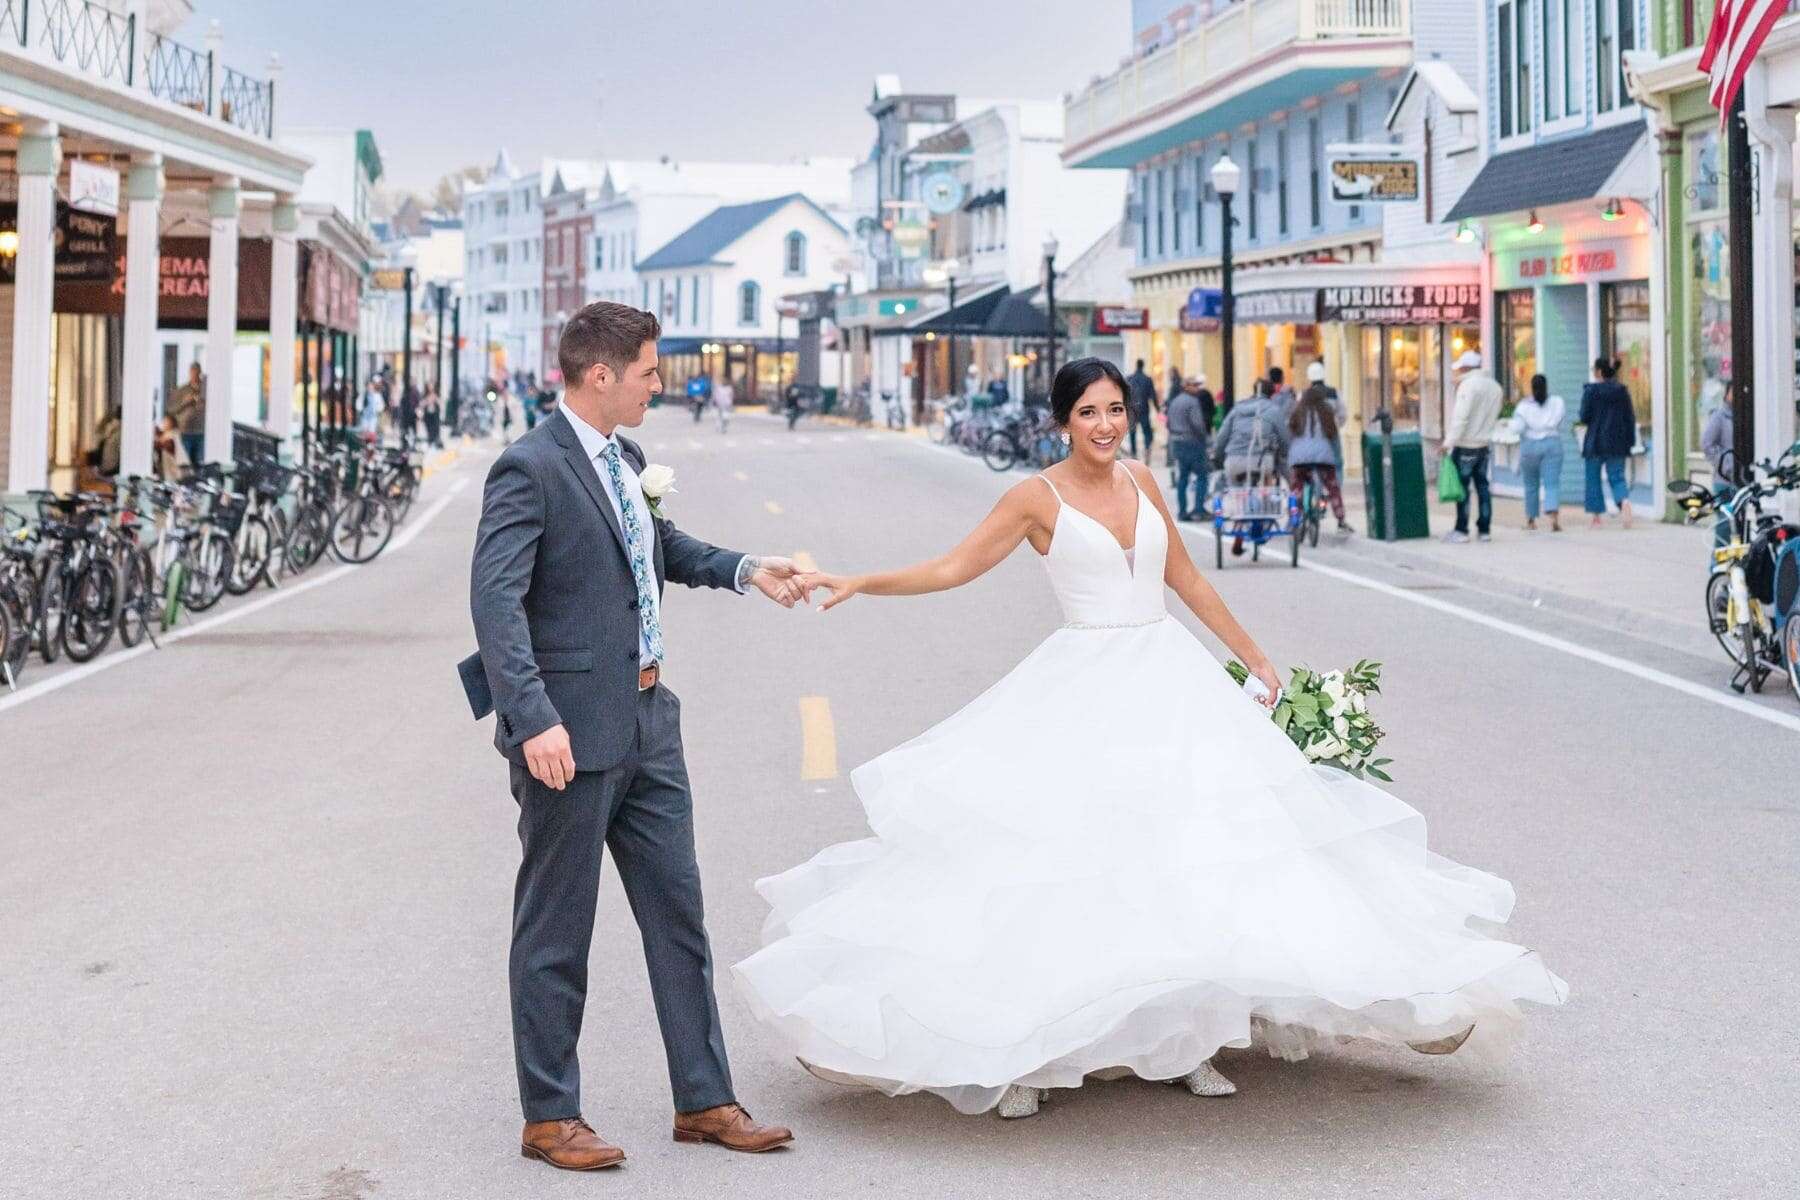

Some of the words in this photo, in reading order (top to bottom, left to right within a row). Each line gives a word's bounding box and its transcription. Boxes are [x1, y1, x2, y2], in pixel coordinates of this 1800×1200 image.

[1373, 175, 1417, 194] FUDGE
[1324, 286, 1415, 306] MURDICKS
[1423, 286, 1480, 305] FUDGE
